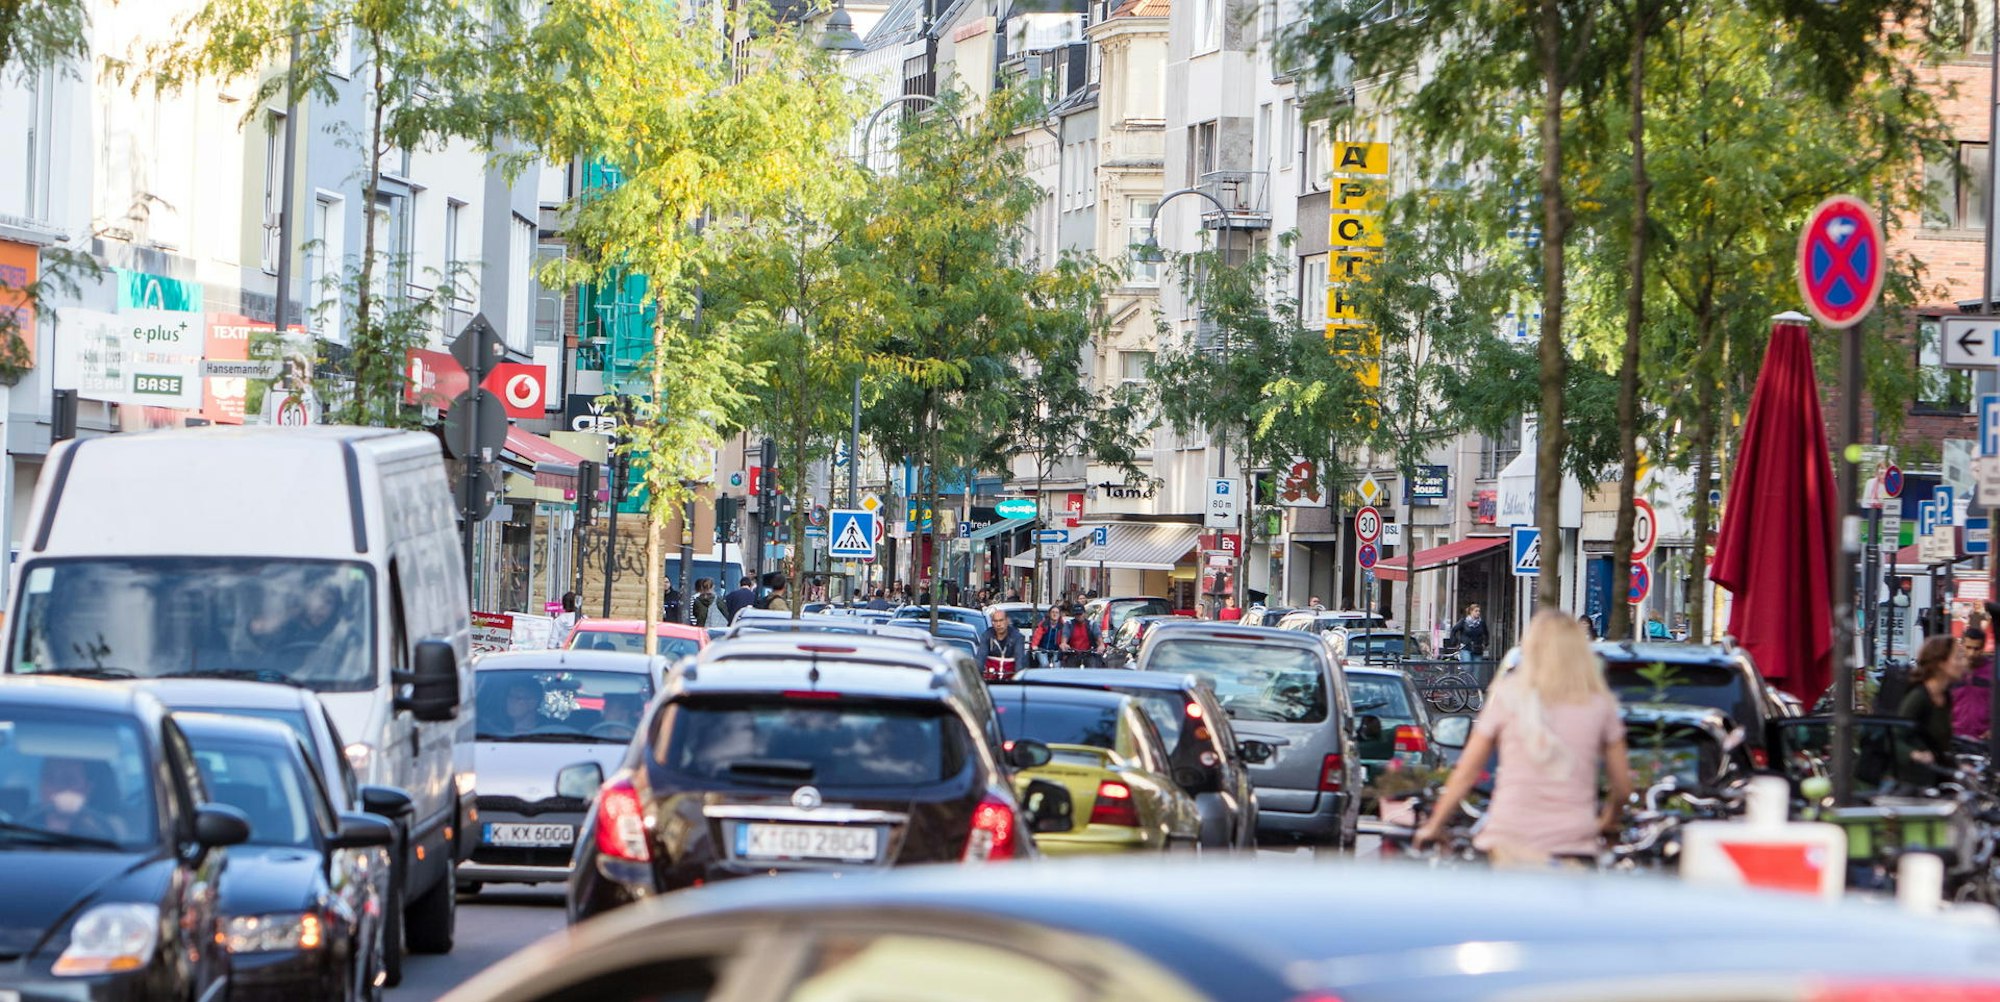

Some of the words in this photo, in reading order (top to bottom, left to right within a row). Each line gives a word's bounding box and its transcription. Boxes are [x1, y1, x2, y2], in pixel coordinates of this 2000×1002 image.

[136, 377, 180, 392] BASE
[284, 408, 301, 426] 30
[1212, 500, 1224, 509] 80
[1225, 501, 1232, 509] m
[1936, 491, 1950, 525] P
[1360, 517, 1376, 533] 30
[1385, 525, 1400, 535] DSL
[493, 826, 502, 840] K
[512, 826, 531, 841] KX
[535, 826, 572, 841] 6000
[749, 830, 765, 850] K
[781, 830, 811, 852] GD
[816, 831, 870, 853] 2804
